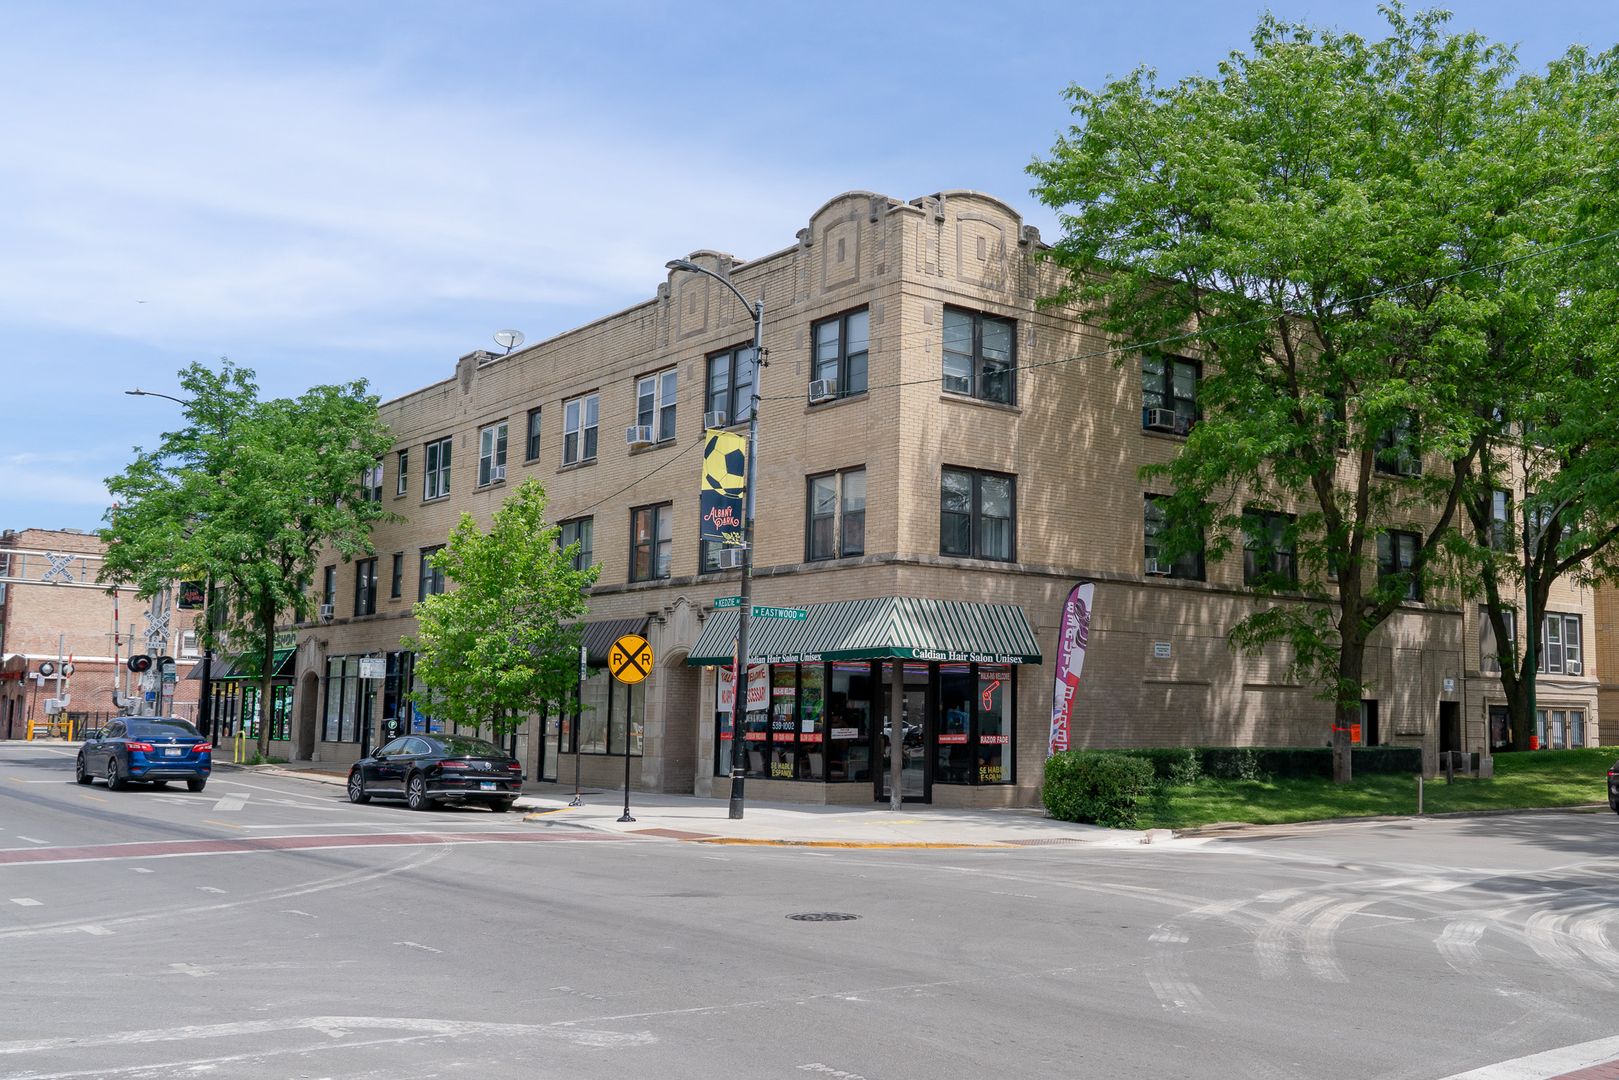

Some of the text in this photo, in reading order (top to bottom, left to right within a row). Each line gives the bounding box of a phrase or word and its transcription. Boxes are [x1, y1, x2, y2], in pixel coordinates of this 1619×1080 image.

[718, 598, 735, 607] KEDZIE
[760, 608, 798, 619] EASTWOOD
[1061, 601, 1075, 678] BEAUTY
[613, 653, 651, 665] R R
[767, 654, 781, 663] Hair
[781, 653, 799, 663] Salon
[800, 652, 822, 662] Unisex
[912, 648, 1023, 664] Caldian Hair Salon Unisex
[1055, 685, 1075, 751] BARBE
[772, 721, 795, 730] 539-1002
[980, 735, 1009, 744] RAZOR FADE
[979, 766, 987, 775] SE
